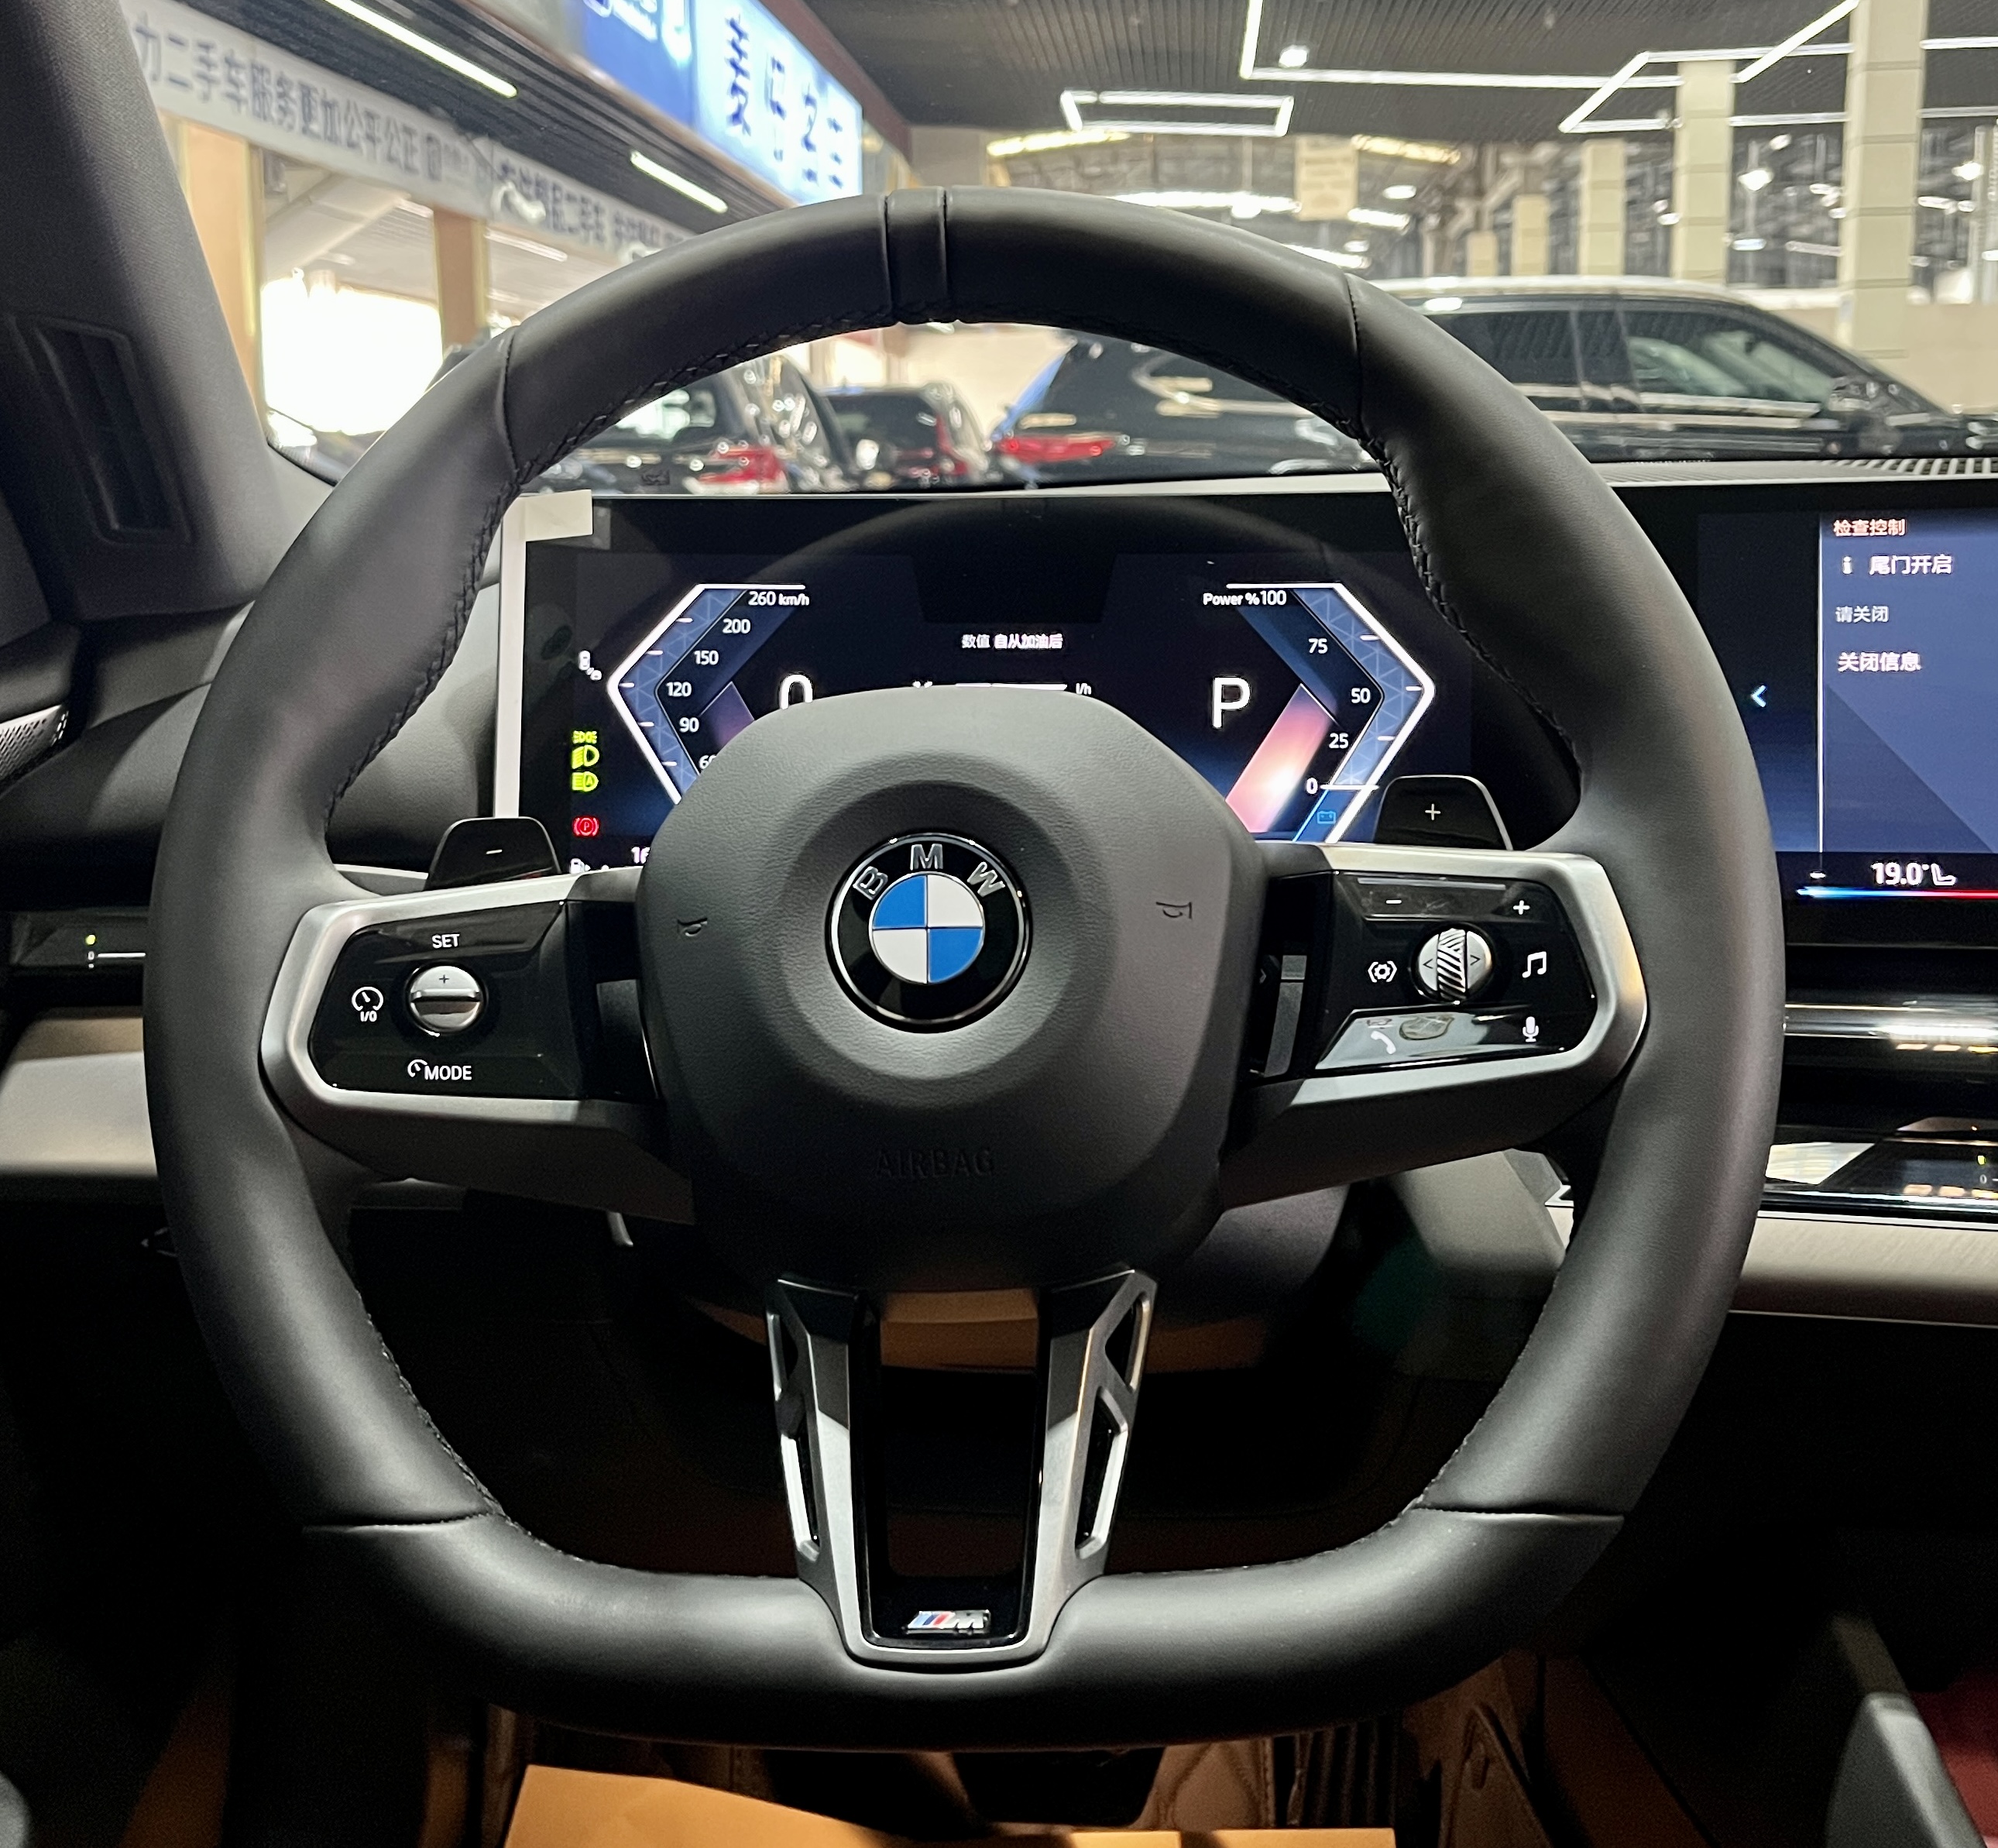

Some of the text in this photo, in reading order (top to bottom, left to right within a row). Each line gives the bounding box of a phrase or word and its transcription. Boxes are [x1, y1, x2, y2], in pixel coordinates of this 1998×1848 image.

[1832, 518, 1907, 538] 检查控制
[1869, 554, 1953, 575] 尾门开启
[747, 590, 810, 606] 260 km/h
[1203, 593, 1244, 606] Power
[1835, 605, 1890, 623] 请关闭
[722, 618, 751, 634] 200
[961, 633, 1064, 650] 数值 自从加油后
[1308, 637, 1329, 654] 75
[694, 651, 719, 666] 150
[1836, 651, 1922, 673] 关闭信息
[665, 681, 693, 697] 120
[1351, 687, 1371, 704] 50
[1212, 675, 1251, 729] P
[678, 716, 701, 733] 90
[1328, 733, 1350, 750] 25
[1305, 777, 1319, 795] 0
[853, 843, 1006, 901] BMW
[431, 933, 461, 949] SET
[424, 1064, 472, 1081] MODE
[875, 1148, 994, 1178] AIRBAG
